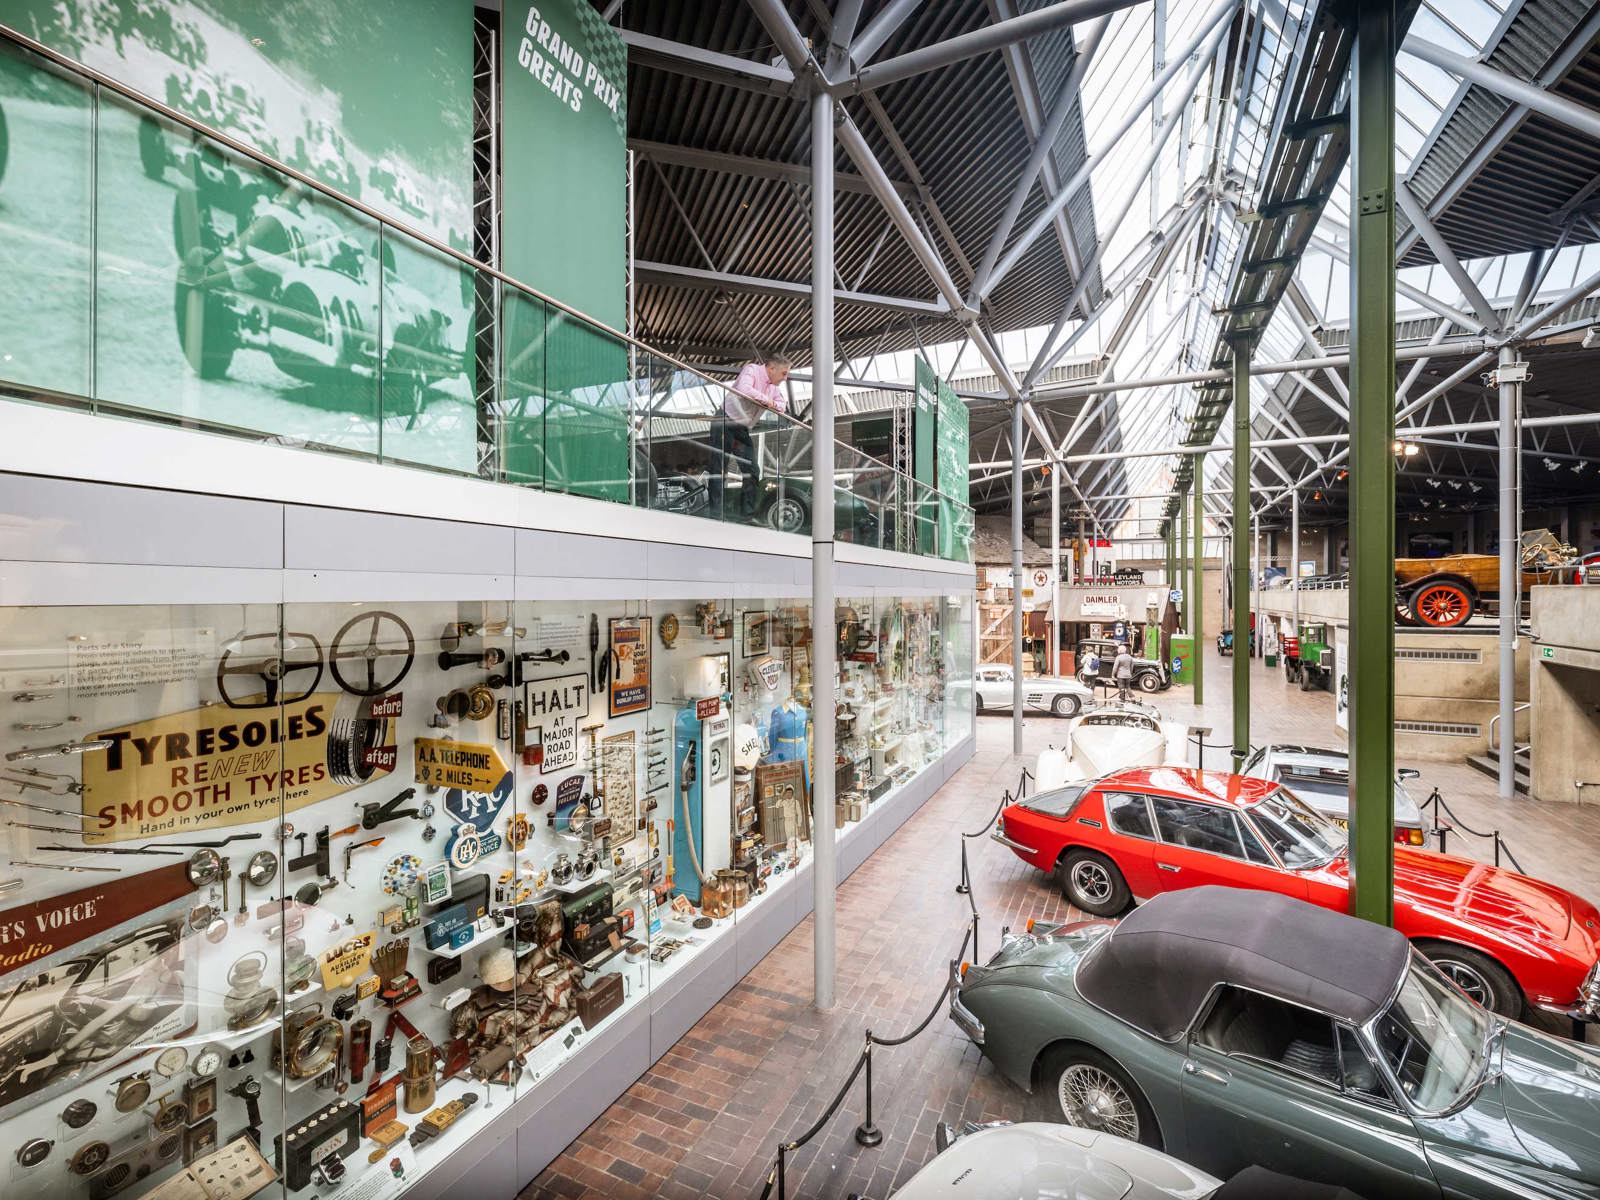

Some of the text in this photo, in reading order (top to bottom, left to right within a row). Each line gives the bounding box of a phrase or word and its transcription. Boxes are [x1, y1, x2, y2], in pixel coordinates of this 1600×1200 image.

[525, 6, 622, 113] GRAND PRIX
[518, 37, 583, 112] GREATS
[77, 643, 98, 651] Parts
[121, 641, 143, 650] Story
[100, 651, 130, 659] steering
[132, 648, 157, 656] wheels
[635, 642, 645, 650] Are
[88, 668, 109, 676] parts
[100, 688, 137, 698] enjoyable
[630, 688, 642, 696] HAVE
[372, 699, 402, 715] before
[532, 685, 584, 716] HALT
[616, 696, 632, 705] DUNLOP
[554, 716, 565, 728] AT
[97, 704, 326, 772] TYRESOLES
[544, 727, 573, 743] MAJOR
[547, 740, 571, 755] ROAD
[366, 749, 395, 766] after
[418, 746, 490, 770] A.A. TELEPHONE
[544, 752, 575, 768] AHEAD
[171, 749, 276, 789] RENEW
[435, 768, 473, 786] 2 MILES
[560, 778, 581, 790] LUCAS
[98, 762, 325, 829] SMOOTH TYRES
[140, 819, 174, 834] Hand
[180, 815, 191, 825] in
[194, 808, 224, 822] your
[227, 801, 250, 814] own
[285, 789, 310, 800] here
[459, 839, 477, 862] RAC
[479, 842, 499, 856] RVICE
[327, 935, 371, 963] LUCAS
[371, 936, 410, 962] LUCAS
[330, 953, 365, 973] AUXILIARY
[335, 961, 360, 975] LAMPS
